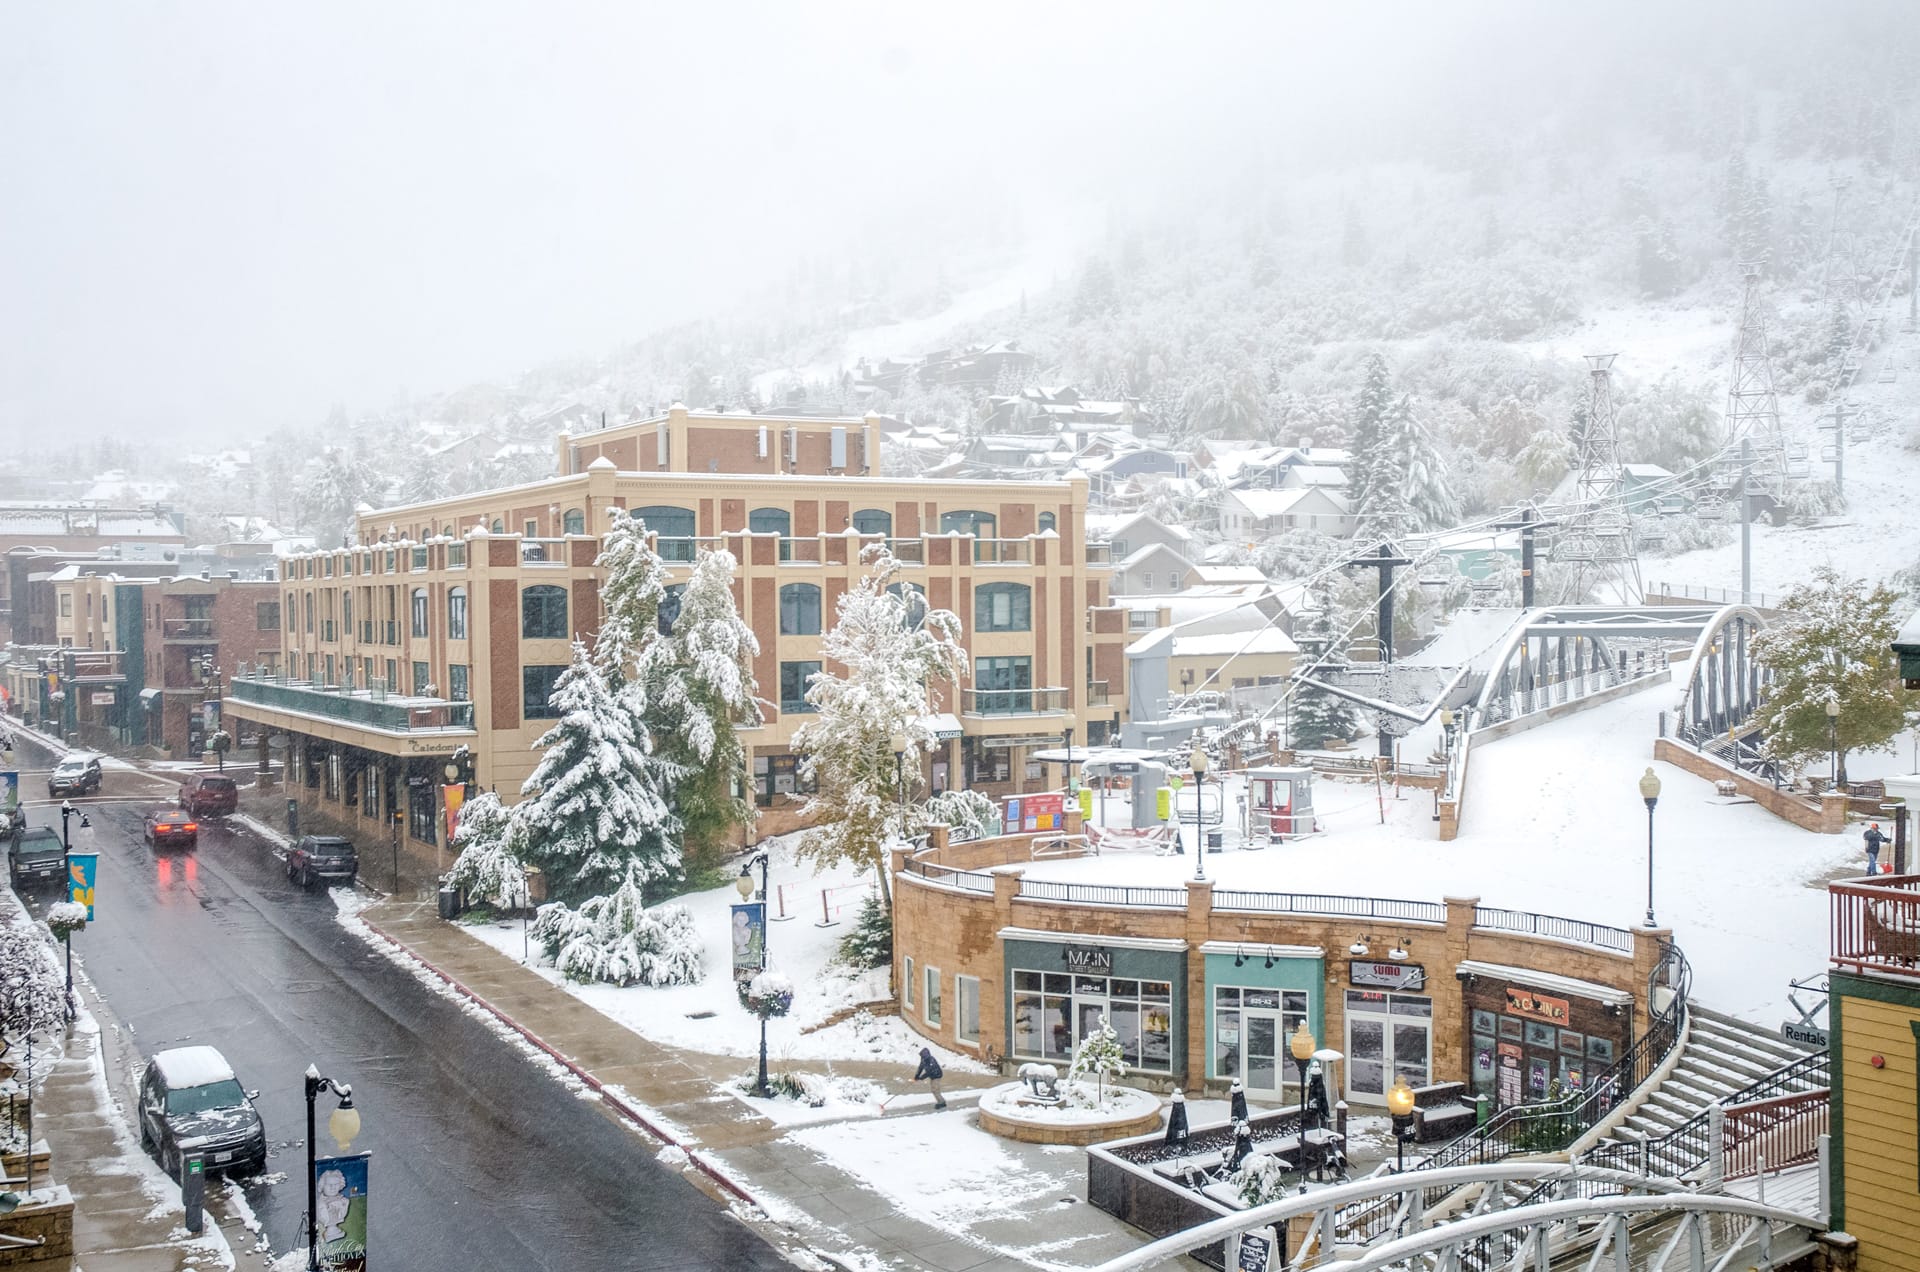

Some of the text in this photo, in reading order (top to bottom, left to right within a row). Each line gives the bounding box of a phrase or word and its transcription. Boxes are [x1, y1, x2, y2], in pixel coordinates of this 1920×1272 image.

[412, 743, 470, 752] Caledoni
[1068, 950, 1110, 967] MAIN
[1521, 998, 1553, 1018] CAIN
[1785, 1025, 1826, 1046] Rentals
